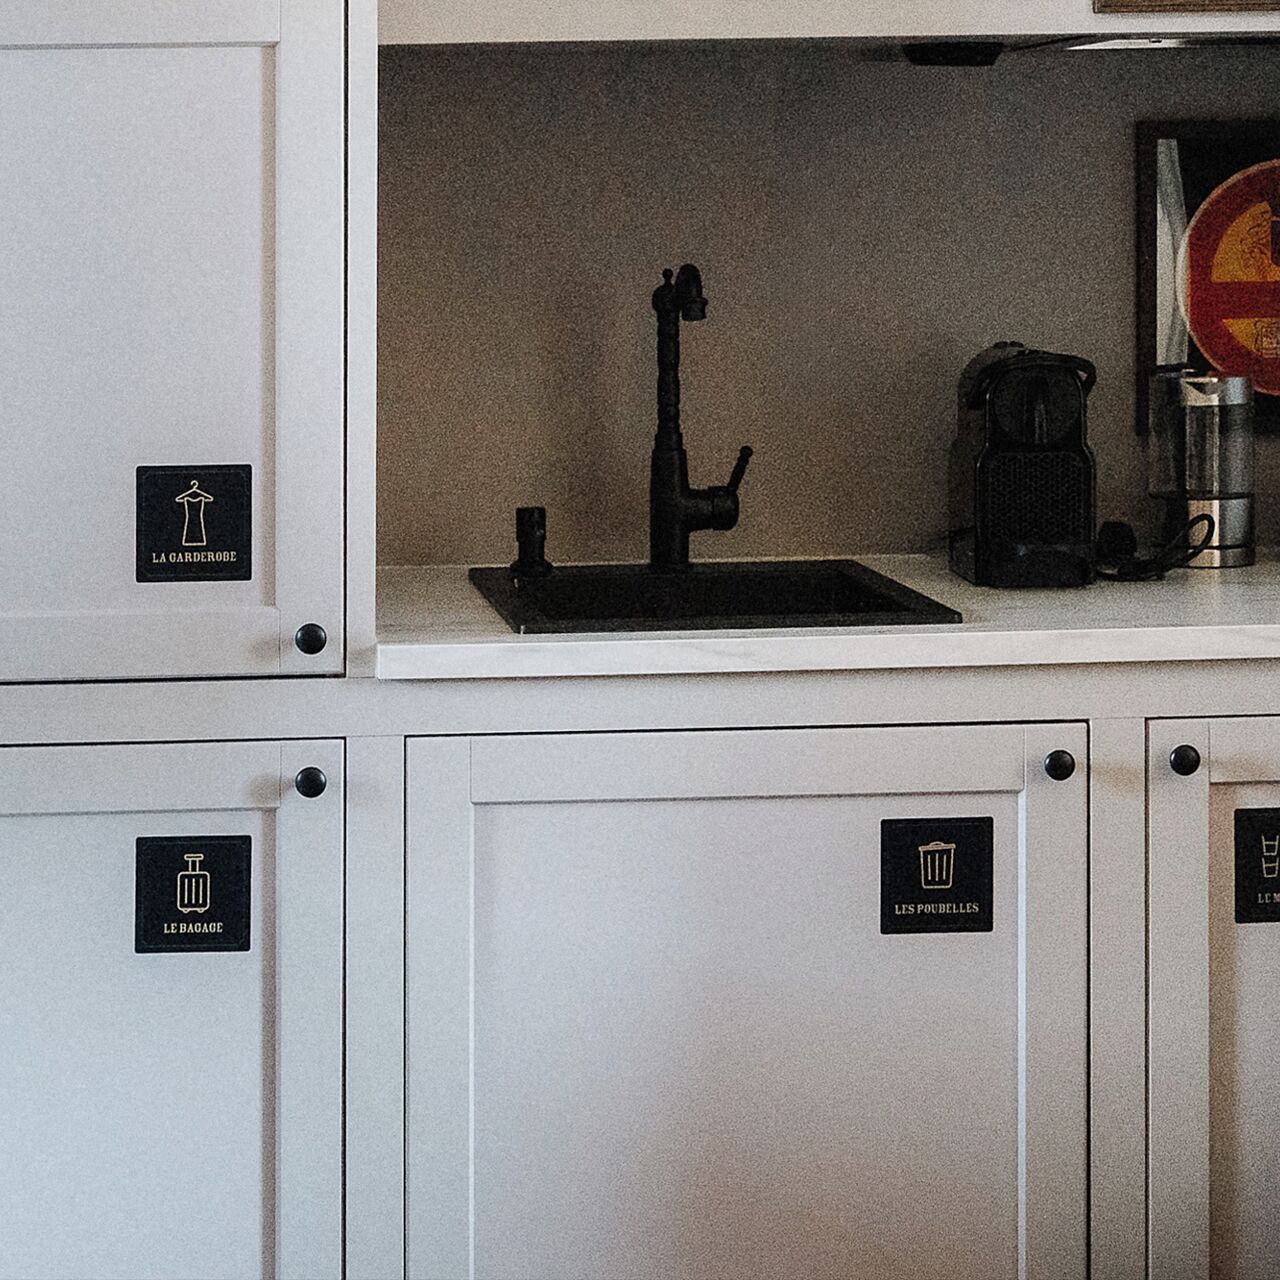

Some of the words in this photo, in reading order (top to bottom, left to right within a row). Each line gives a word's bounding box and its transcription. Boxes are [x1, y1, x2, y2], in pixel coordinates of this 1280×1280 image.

[152, 553, 166, 563] LA
[169, 551, 237, 563] GARDEROBE
[1257, 893, 1271, 903] LE
[895, 904, 915, 915] LES
[917, 902, 980, 914] POUBELLES
[164, 923, 178, 933] LE
[179, 923, 223, 933] BAGAGE
